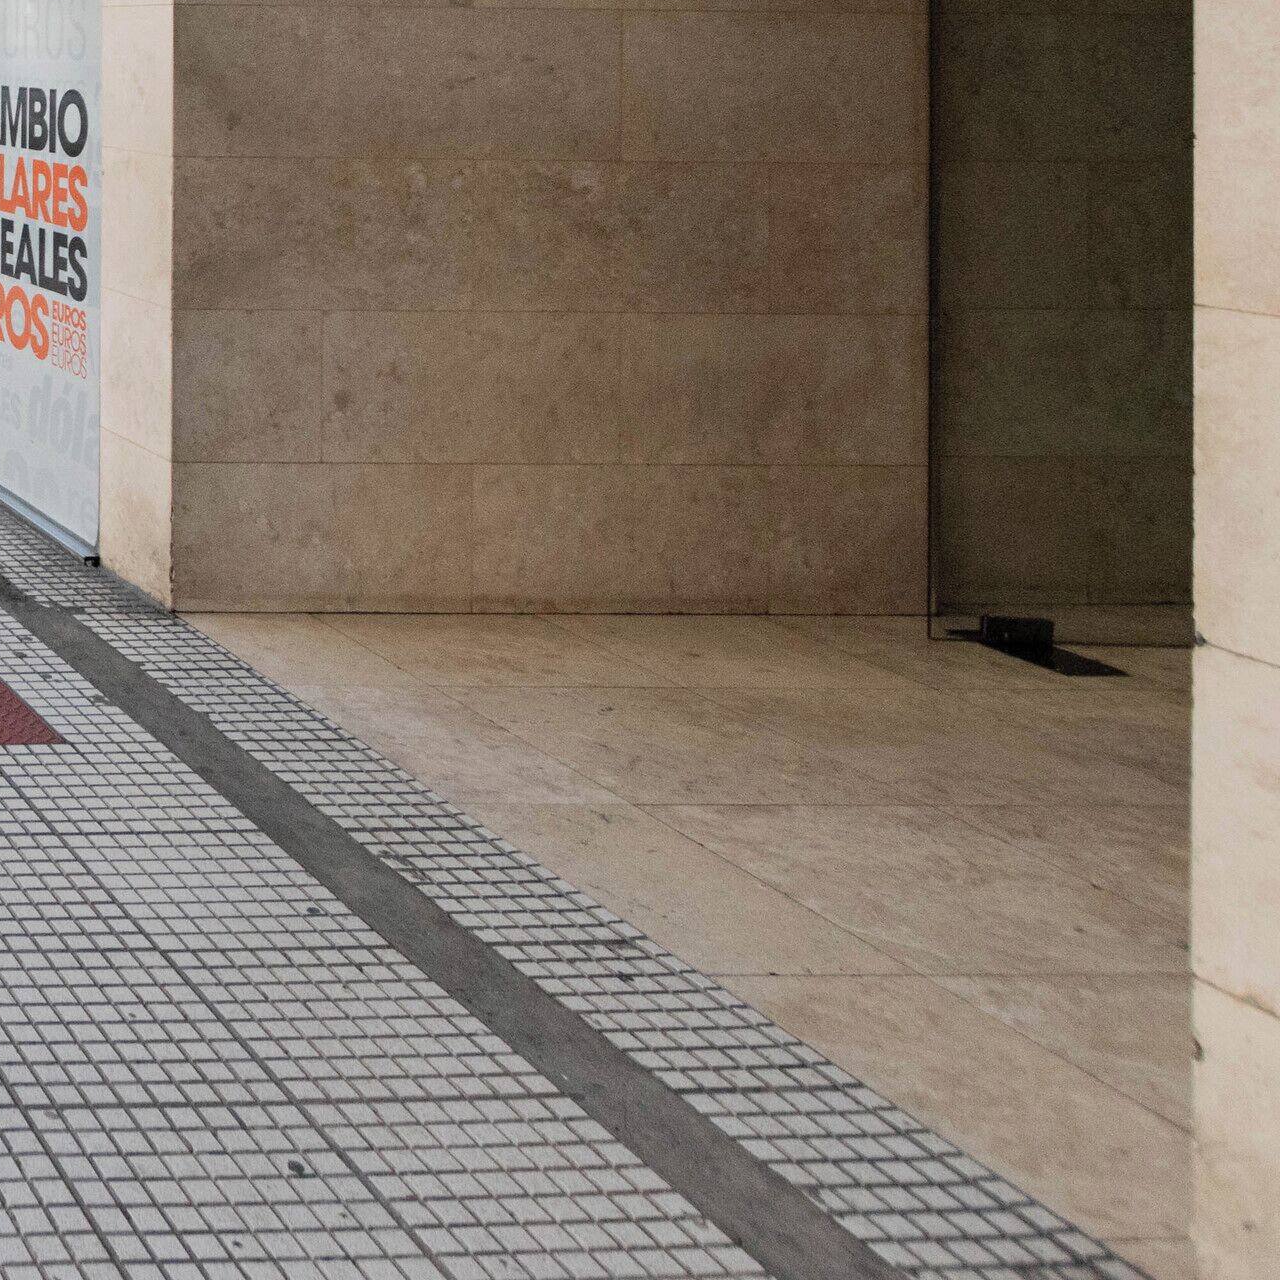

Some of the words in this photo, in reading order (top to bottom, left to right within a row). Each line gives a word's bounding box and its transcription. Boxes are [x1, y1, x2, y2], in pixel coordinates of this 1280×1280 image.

[52, 300, 87, 332] EUROS
[51, 322, 87, 356] EUROS
[51, 344, 87, 380] EUROS
